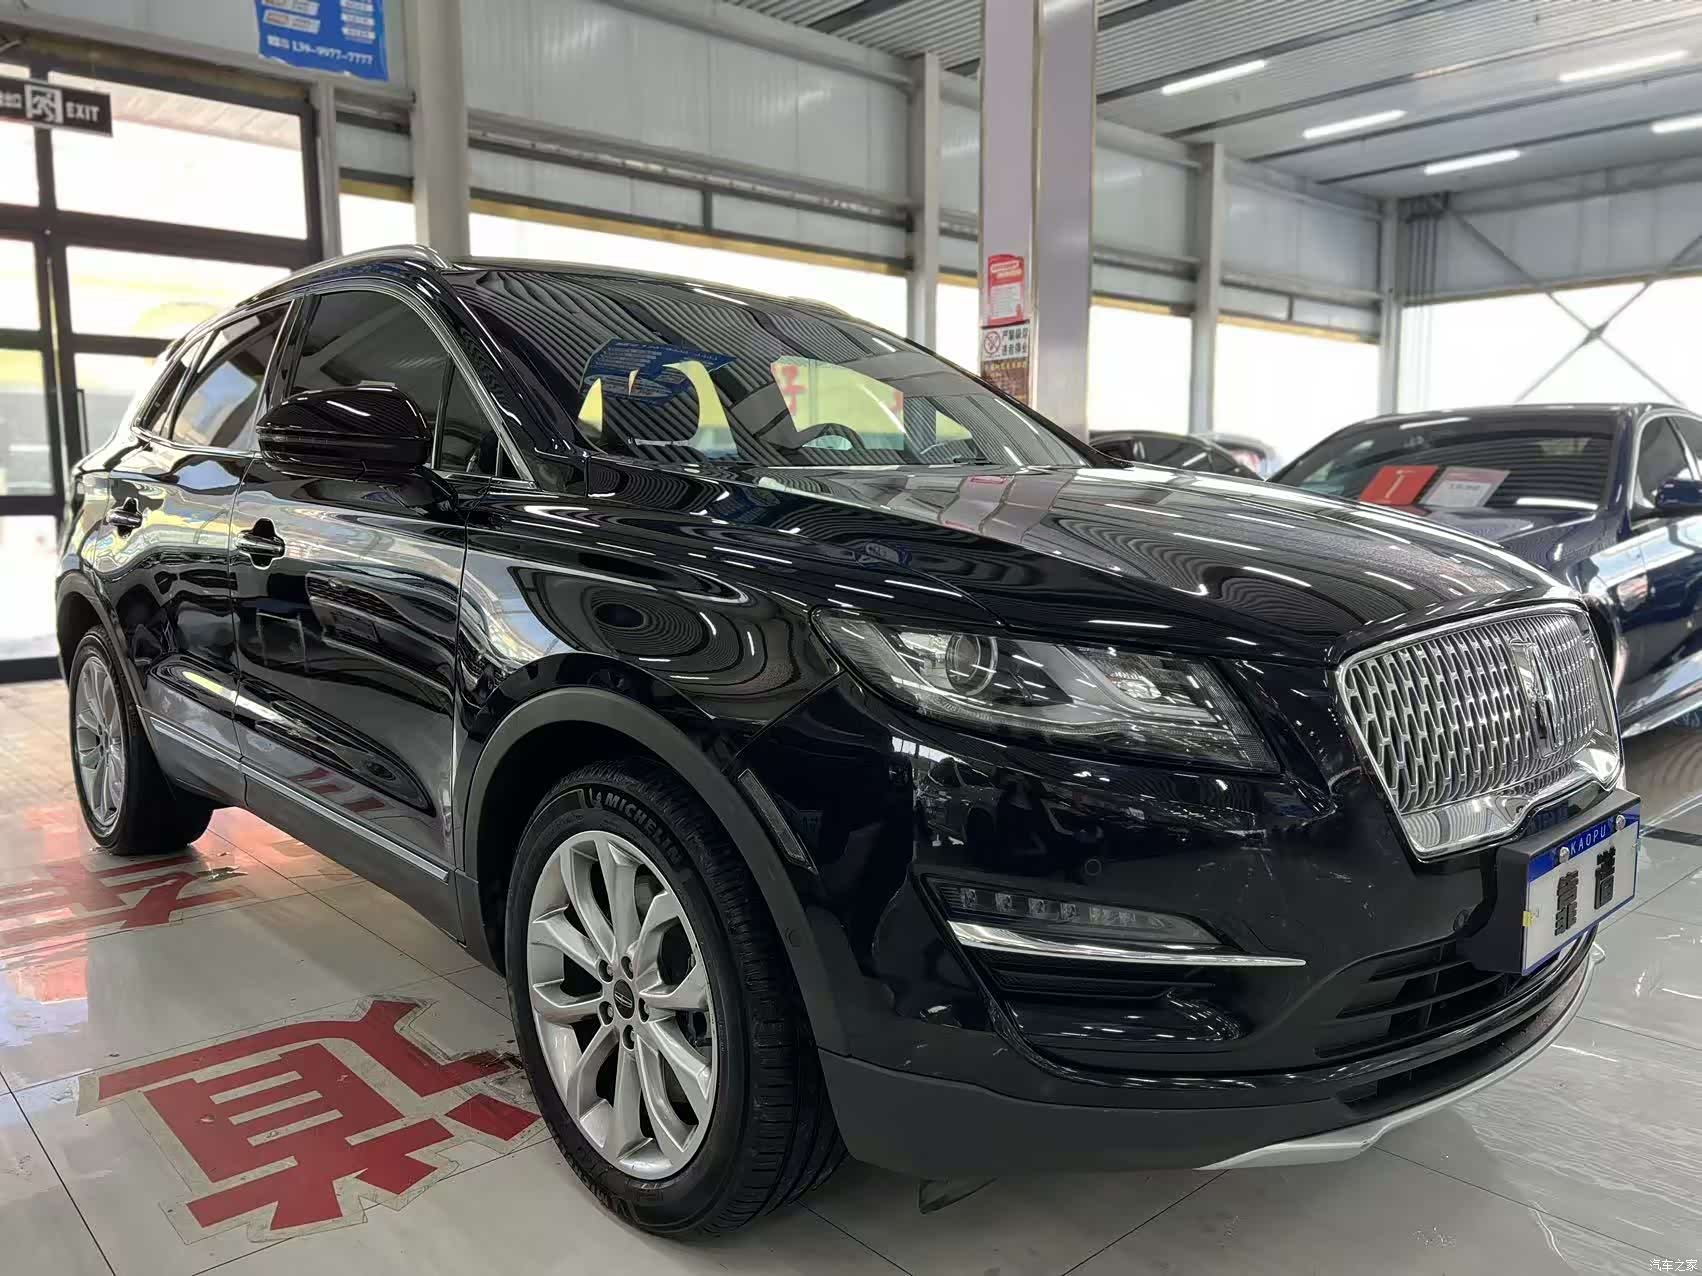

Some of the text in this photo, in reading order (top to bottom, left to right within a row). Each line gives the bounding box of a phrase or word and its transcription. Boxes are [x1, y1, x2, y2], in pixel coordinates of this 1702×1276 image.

[65, 101, 99, 122] EXIT
[604, 792, 681, 866] MICHELIN
[1569, 825, 1608, 857] KAOPU
